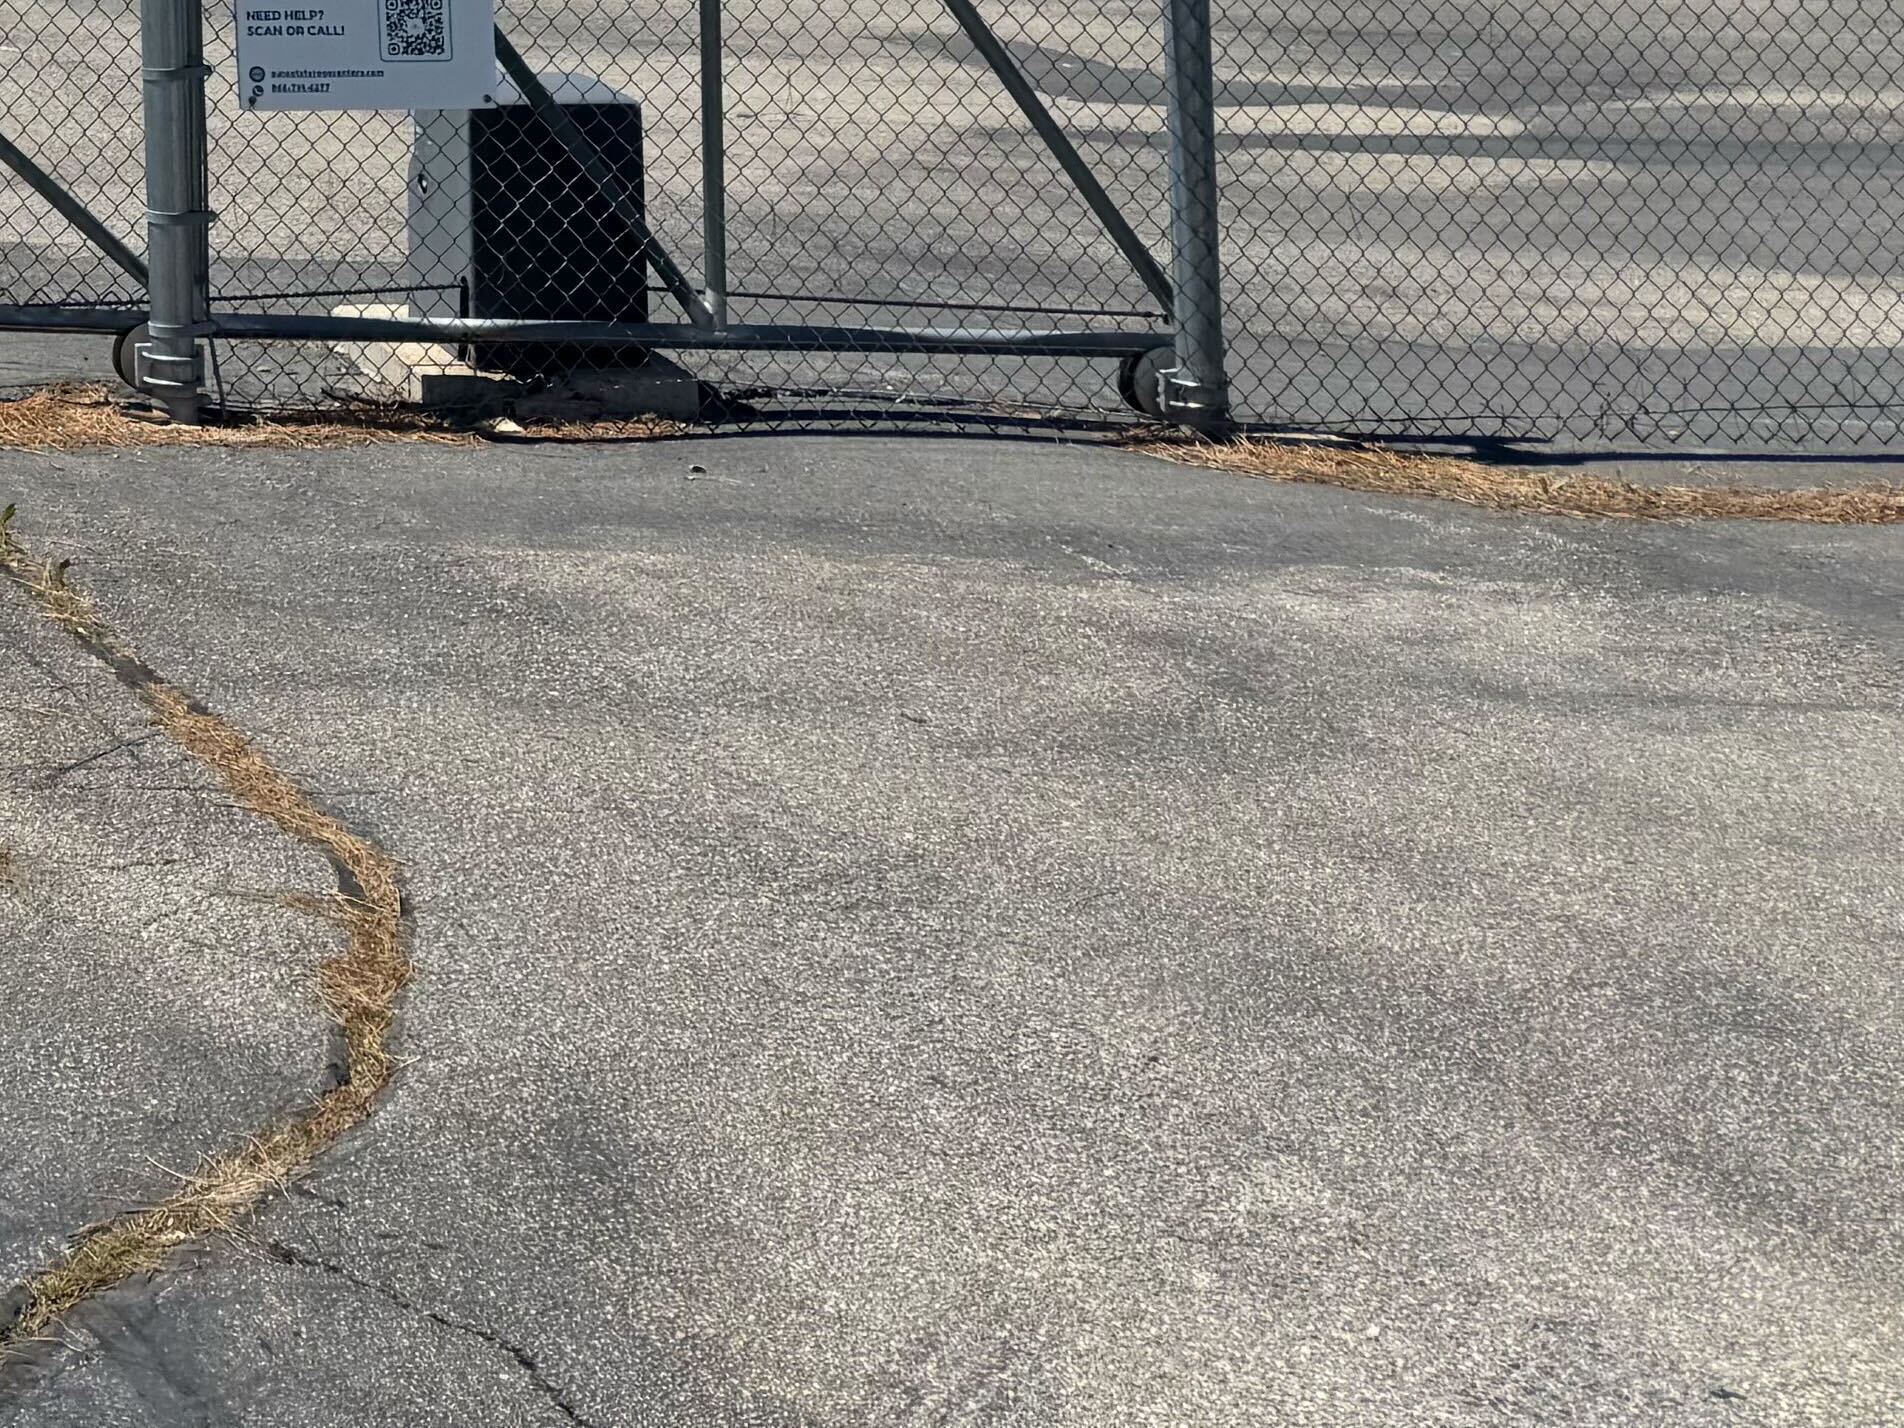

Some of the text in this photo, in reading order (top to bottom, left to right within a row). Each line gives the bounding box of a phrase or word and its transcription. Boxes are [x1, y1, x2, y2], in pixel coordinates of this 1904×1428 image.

[247, 10, 324, 21] NEED HELP?
[247, 25, 345, 36] SCAN OR CALL!
